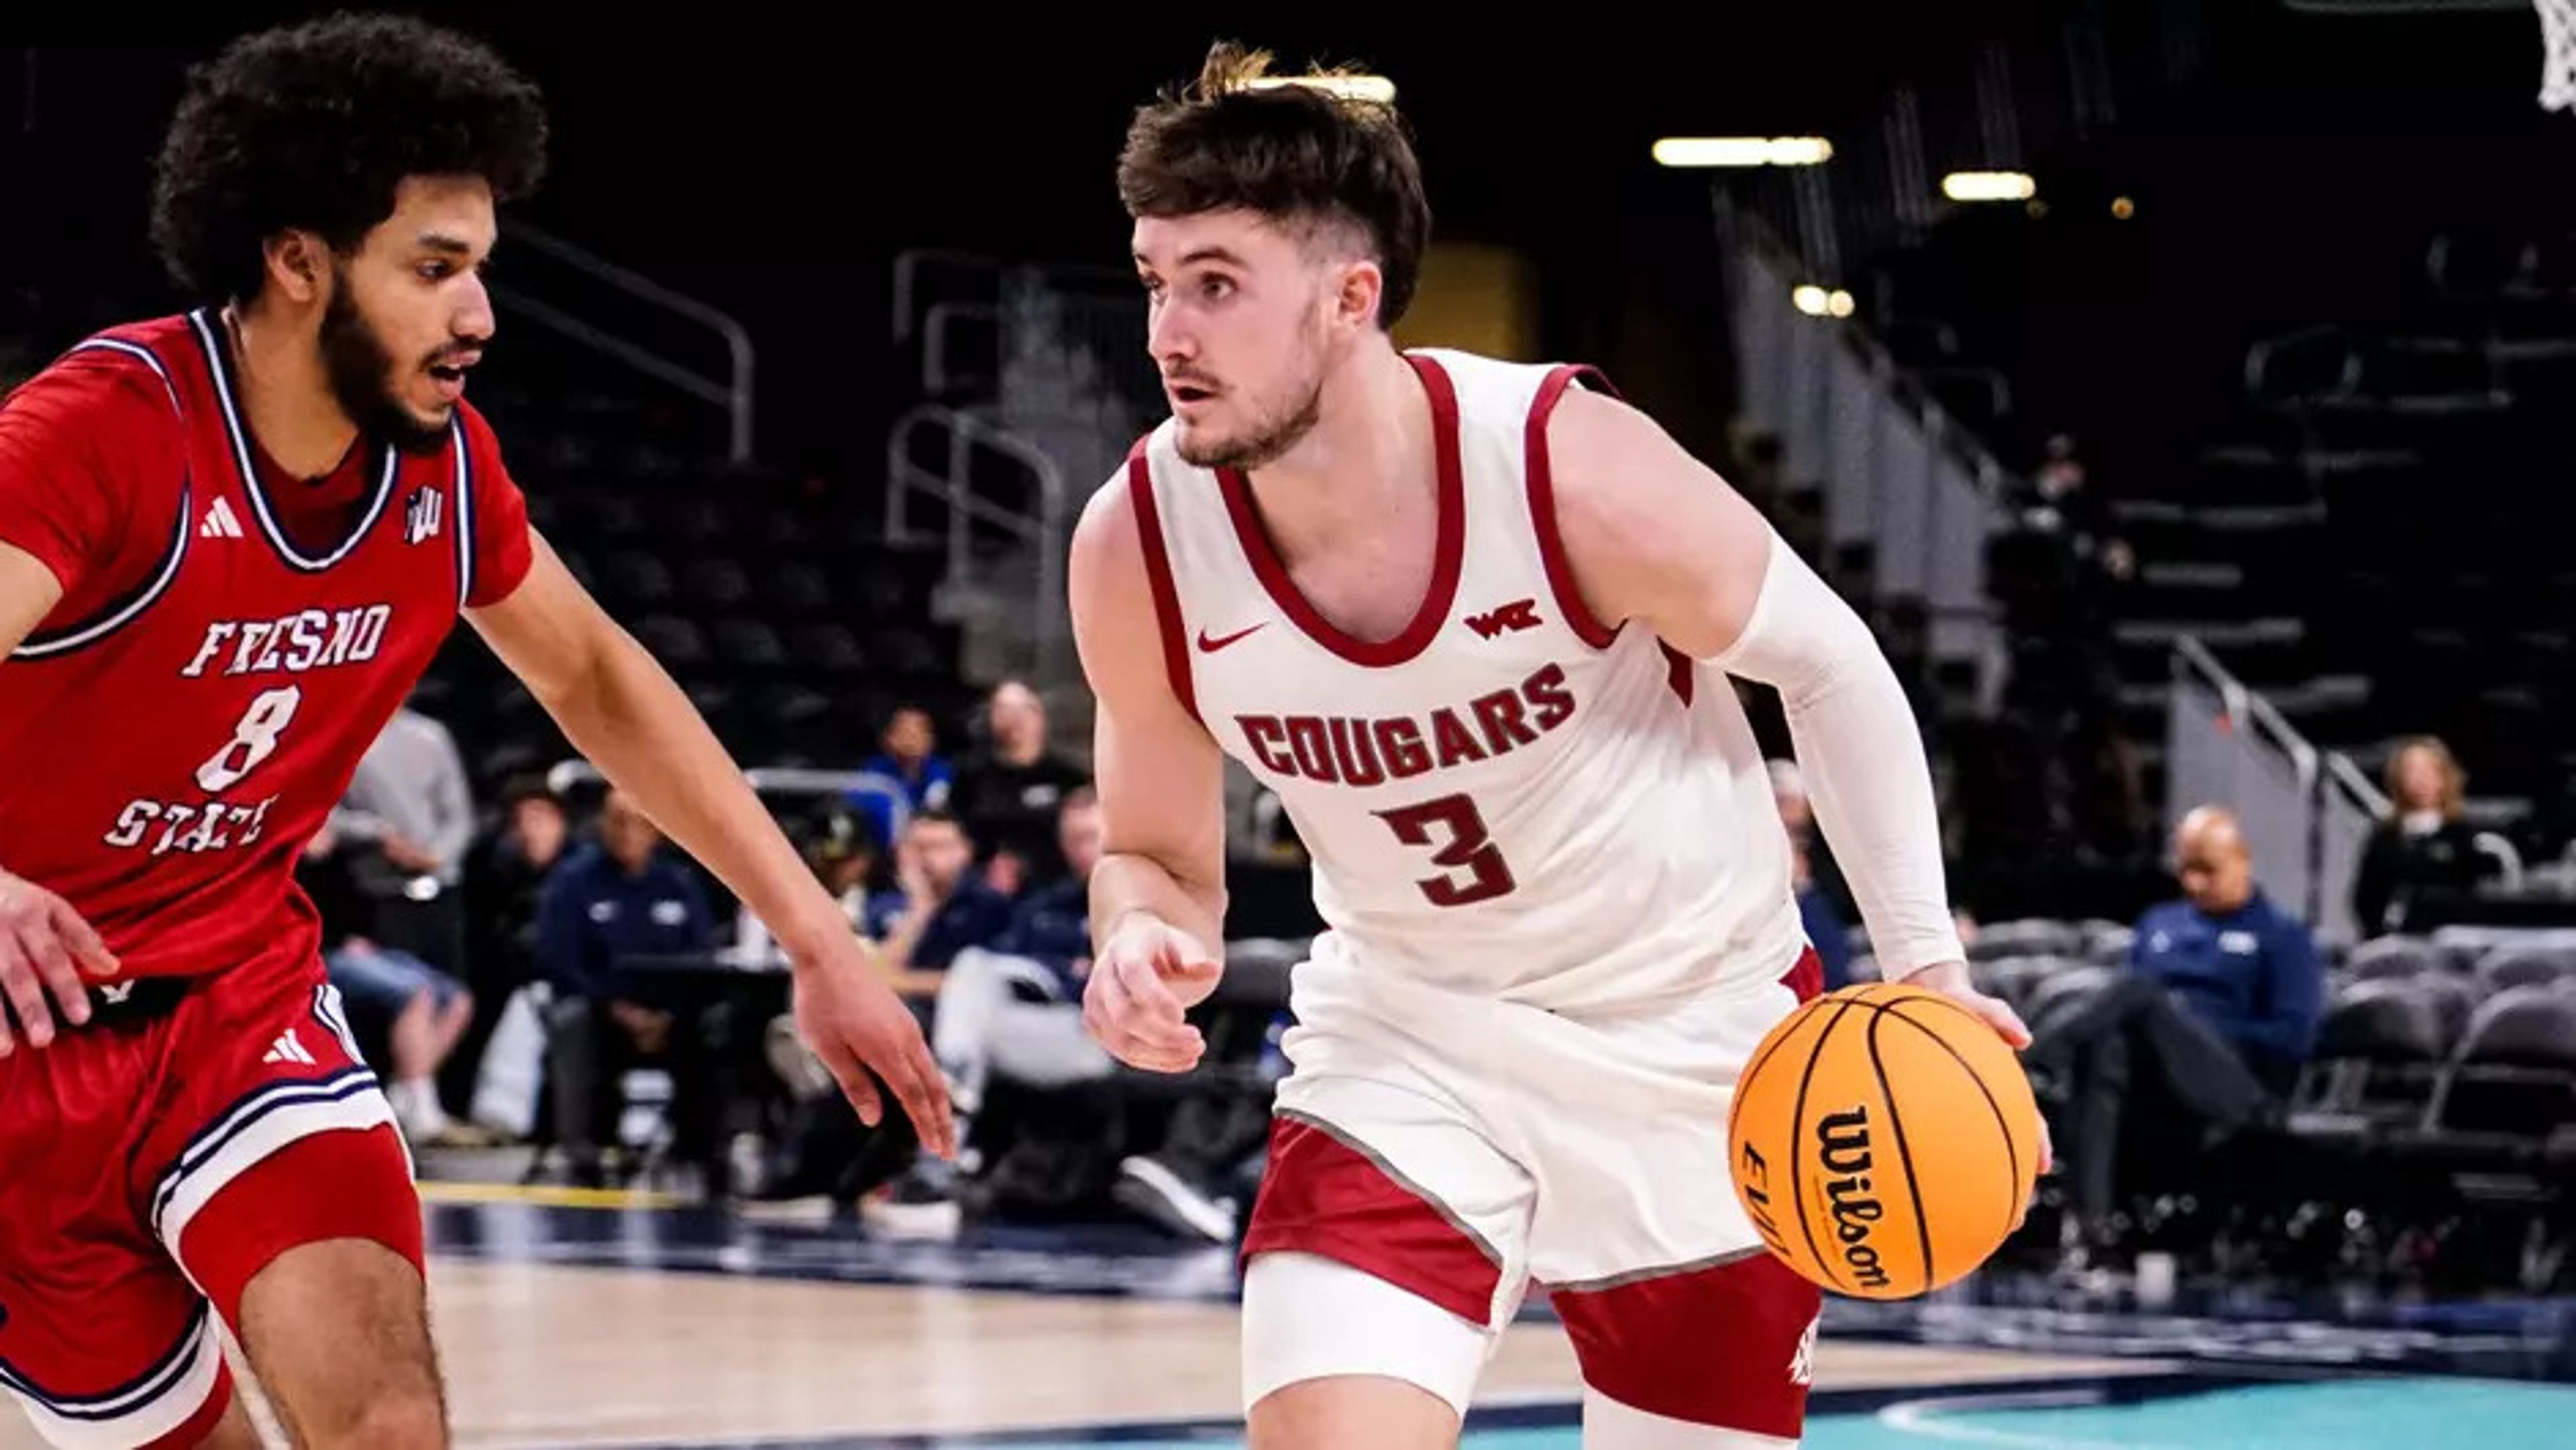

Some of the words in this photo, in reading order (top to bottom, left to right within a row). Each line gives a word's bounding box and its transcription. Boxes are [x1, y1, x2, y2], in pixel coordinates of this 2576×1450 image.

[182, 604, 392, 677] FRESNO
[194, 683, 301, 793] 8
[1233, 662, 1576, 788] COUGARS
[1368, 792, 1517, 908] 3
[1816, 1104, 1890, 1291] Wilson
